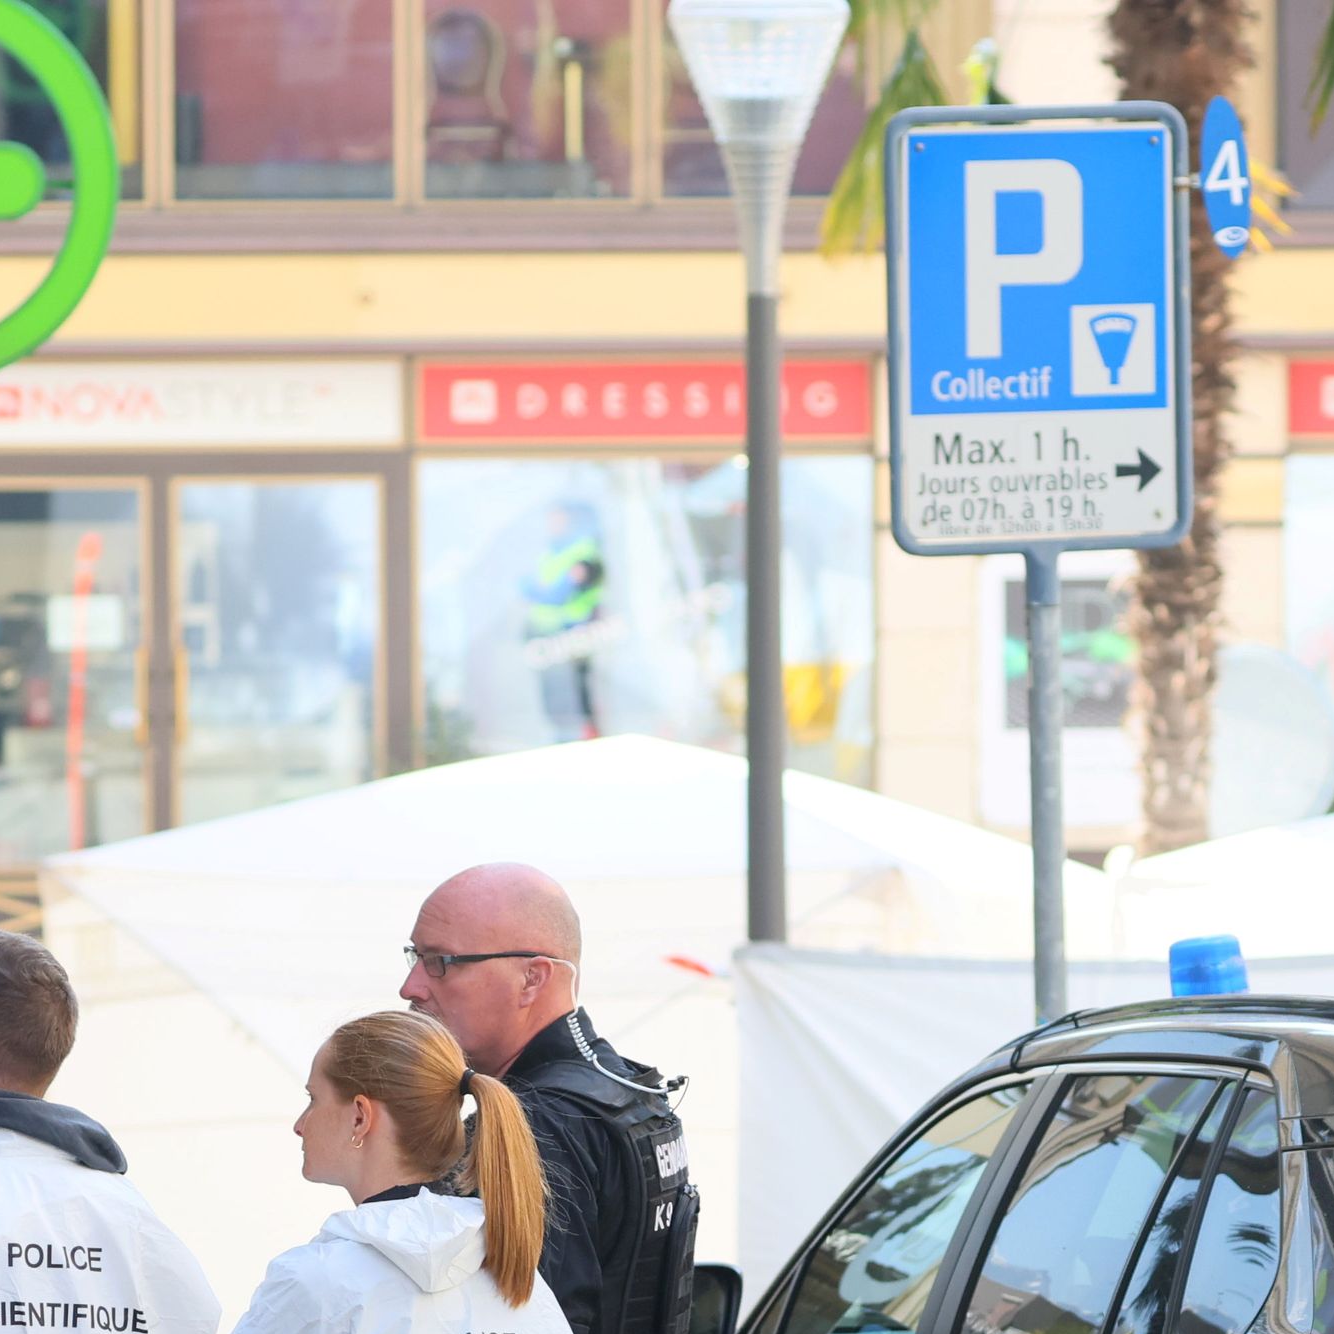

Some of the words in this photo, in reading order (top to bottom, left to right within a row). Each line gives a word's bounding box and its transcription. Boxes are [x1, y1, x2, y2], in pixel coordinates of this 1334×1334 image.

[1204, 139, 1247, 206] 4
[965, 159, 1083, 359] P
[516, 381, 838, 417] DRESSIG
[931, 366, 1052, 401] Collectif
[934, 433, 1016, 465] Max.
[1033, 431, 1043, 461] 1
[1063, 427, 1091, 462] h.
[917, 472, 980, 496] Jours
[991, 468, 1109, 492] ouvrables
[923, 500, 952, 522] de
[961, 498, 1014, 521] 07h.
[1022, 496, 1035, 519] à
[1047, 496, 1074, 519] 19
[1083, 496, 1104, 518] h.
[8, 1242, 103, 1272] POLICE
